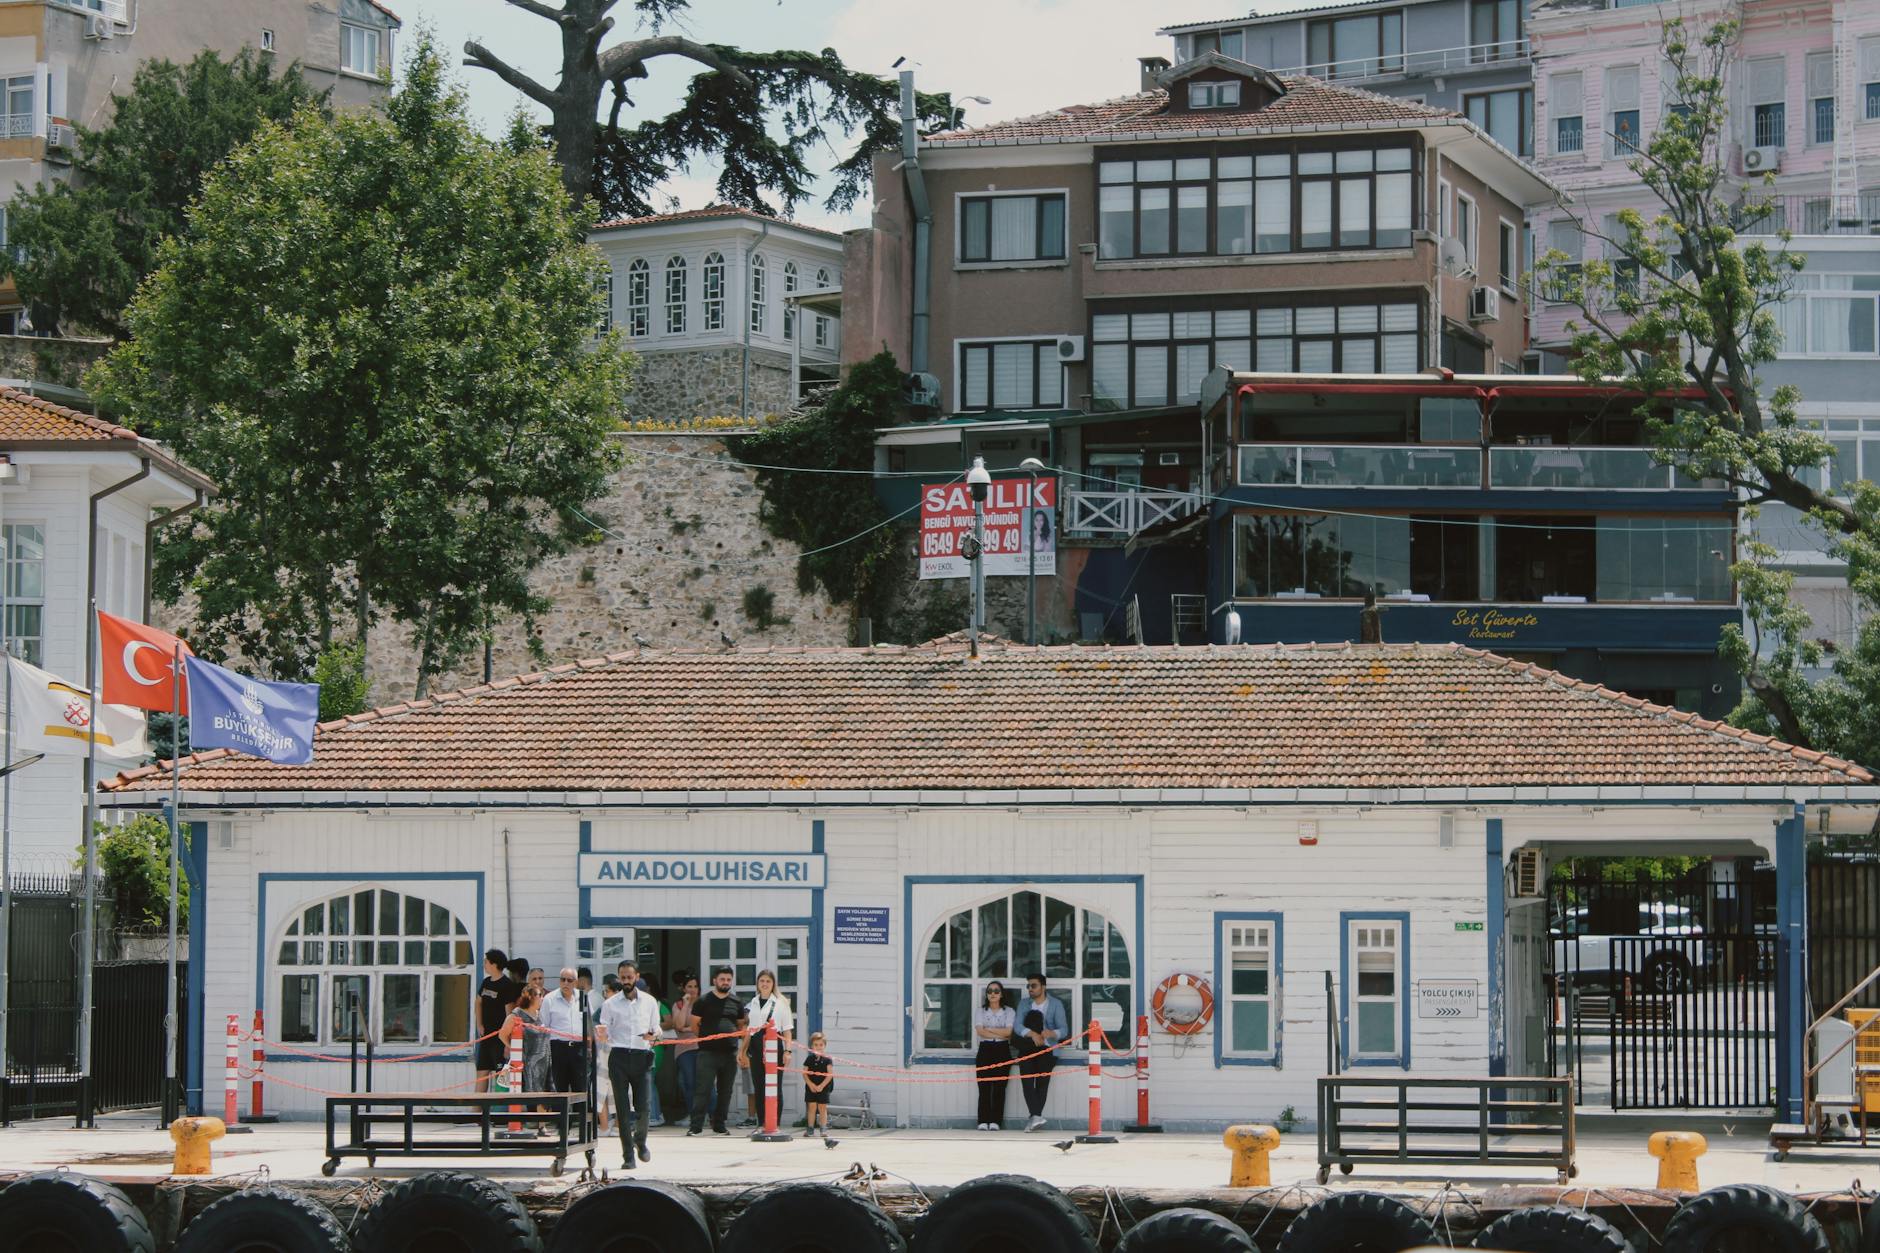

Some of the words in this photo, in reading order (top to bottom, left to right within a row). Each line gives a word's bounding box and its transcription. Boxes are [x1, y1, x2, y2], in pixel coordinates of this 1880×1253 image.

[924, 515, 951, 529] BENGÜ
[924, 532, 954, 555] 0549
[1003, 528, 1020, 552] 49
[1452, 609, 1480, 626] Set
[1482, 609, 1538, 631] Güverte
[1468, 627, 1517, 638] Restaurant
[1450, 990, 1475, 999] ÇIKIŞI
